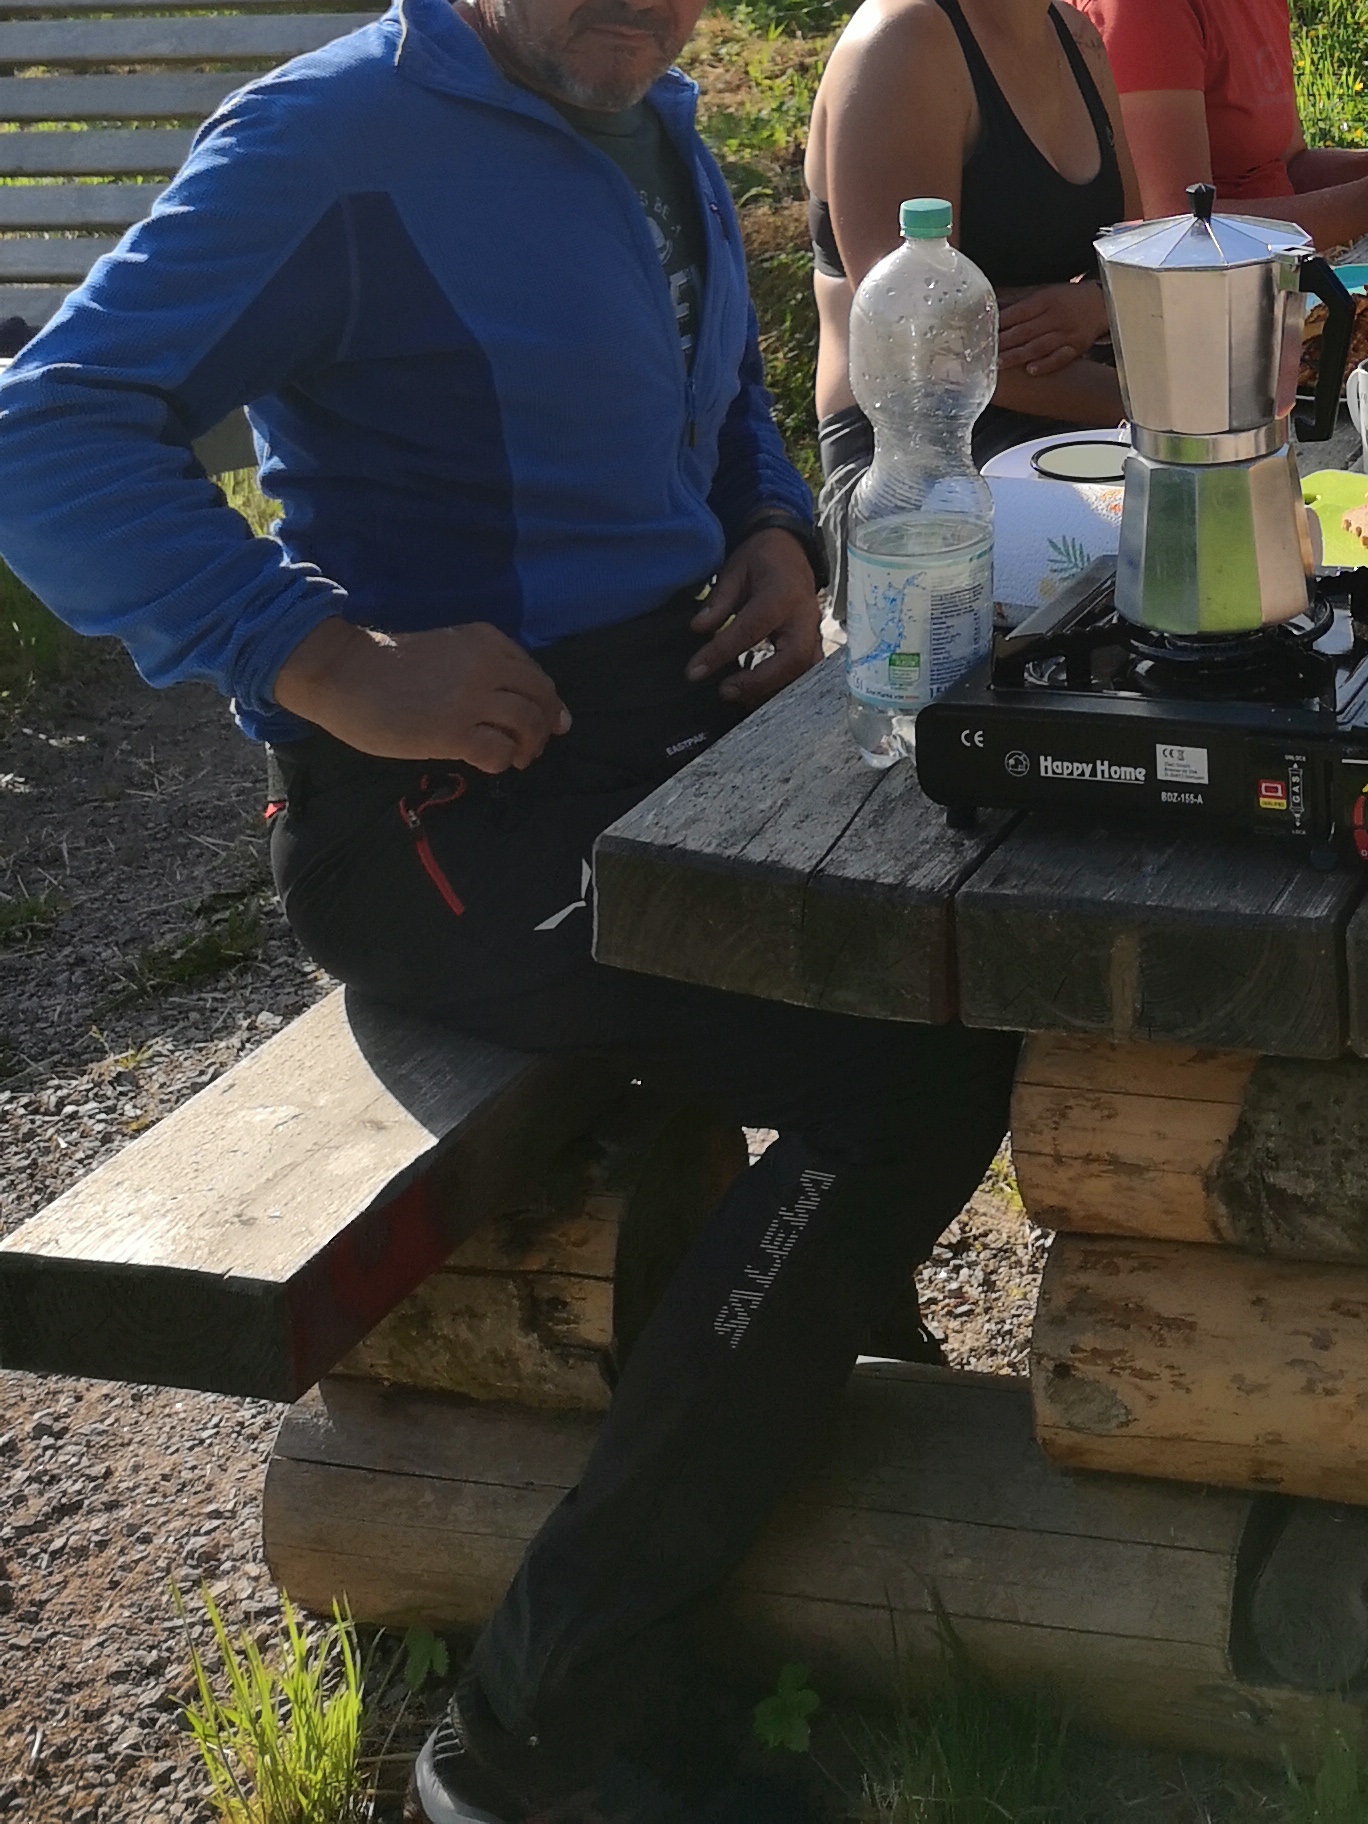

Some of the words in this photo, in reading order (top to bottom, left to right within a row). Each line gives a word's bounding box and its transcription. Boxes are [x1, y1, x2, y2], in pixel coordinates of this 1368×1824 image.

[1039, 755, 1093, 779] Happy
[1096, 760, 1147, 782] Home
[1291, 776, 1301, 803] GAS
